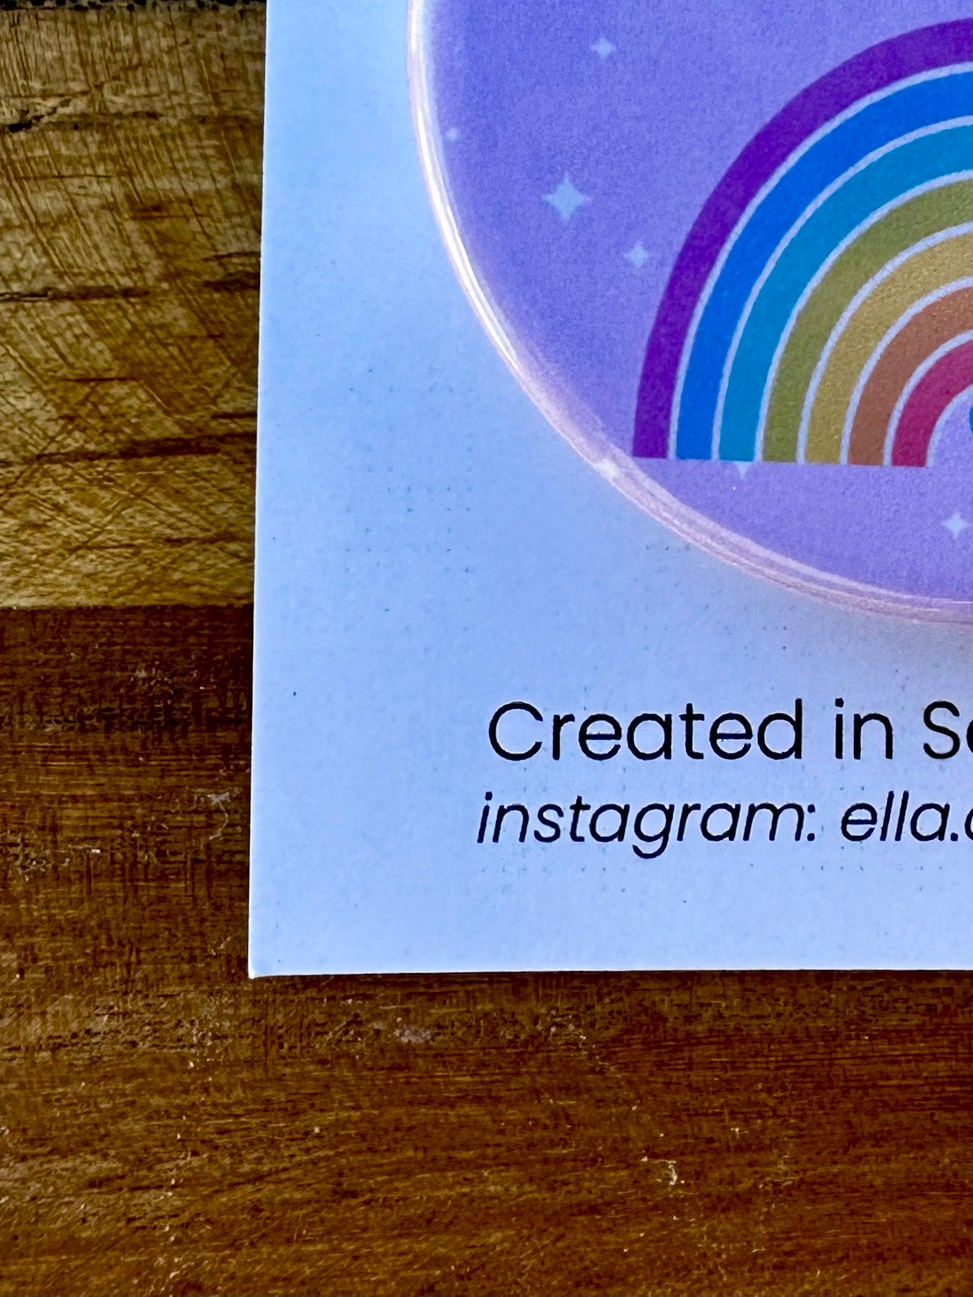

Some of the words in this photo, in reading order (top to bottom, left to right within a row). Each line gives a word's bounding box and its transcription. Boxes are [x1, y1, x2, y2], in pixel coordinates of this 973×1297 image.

[487, 698, 802, 762] Created
[834, 698, 893, 761] in
[477, 791, 818, 859] instagram:
